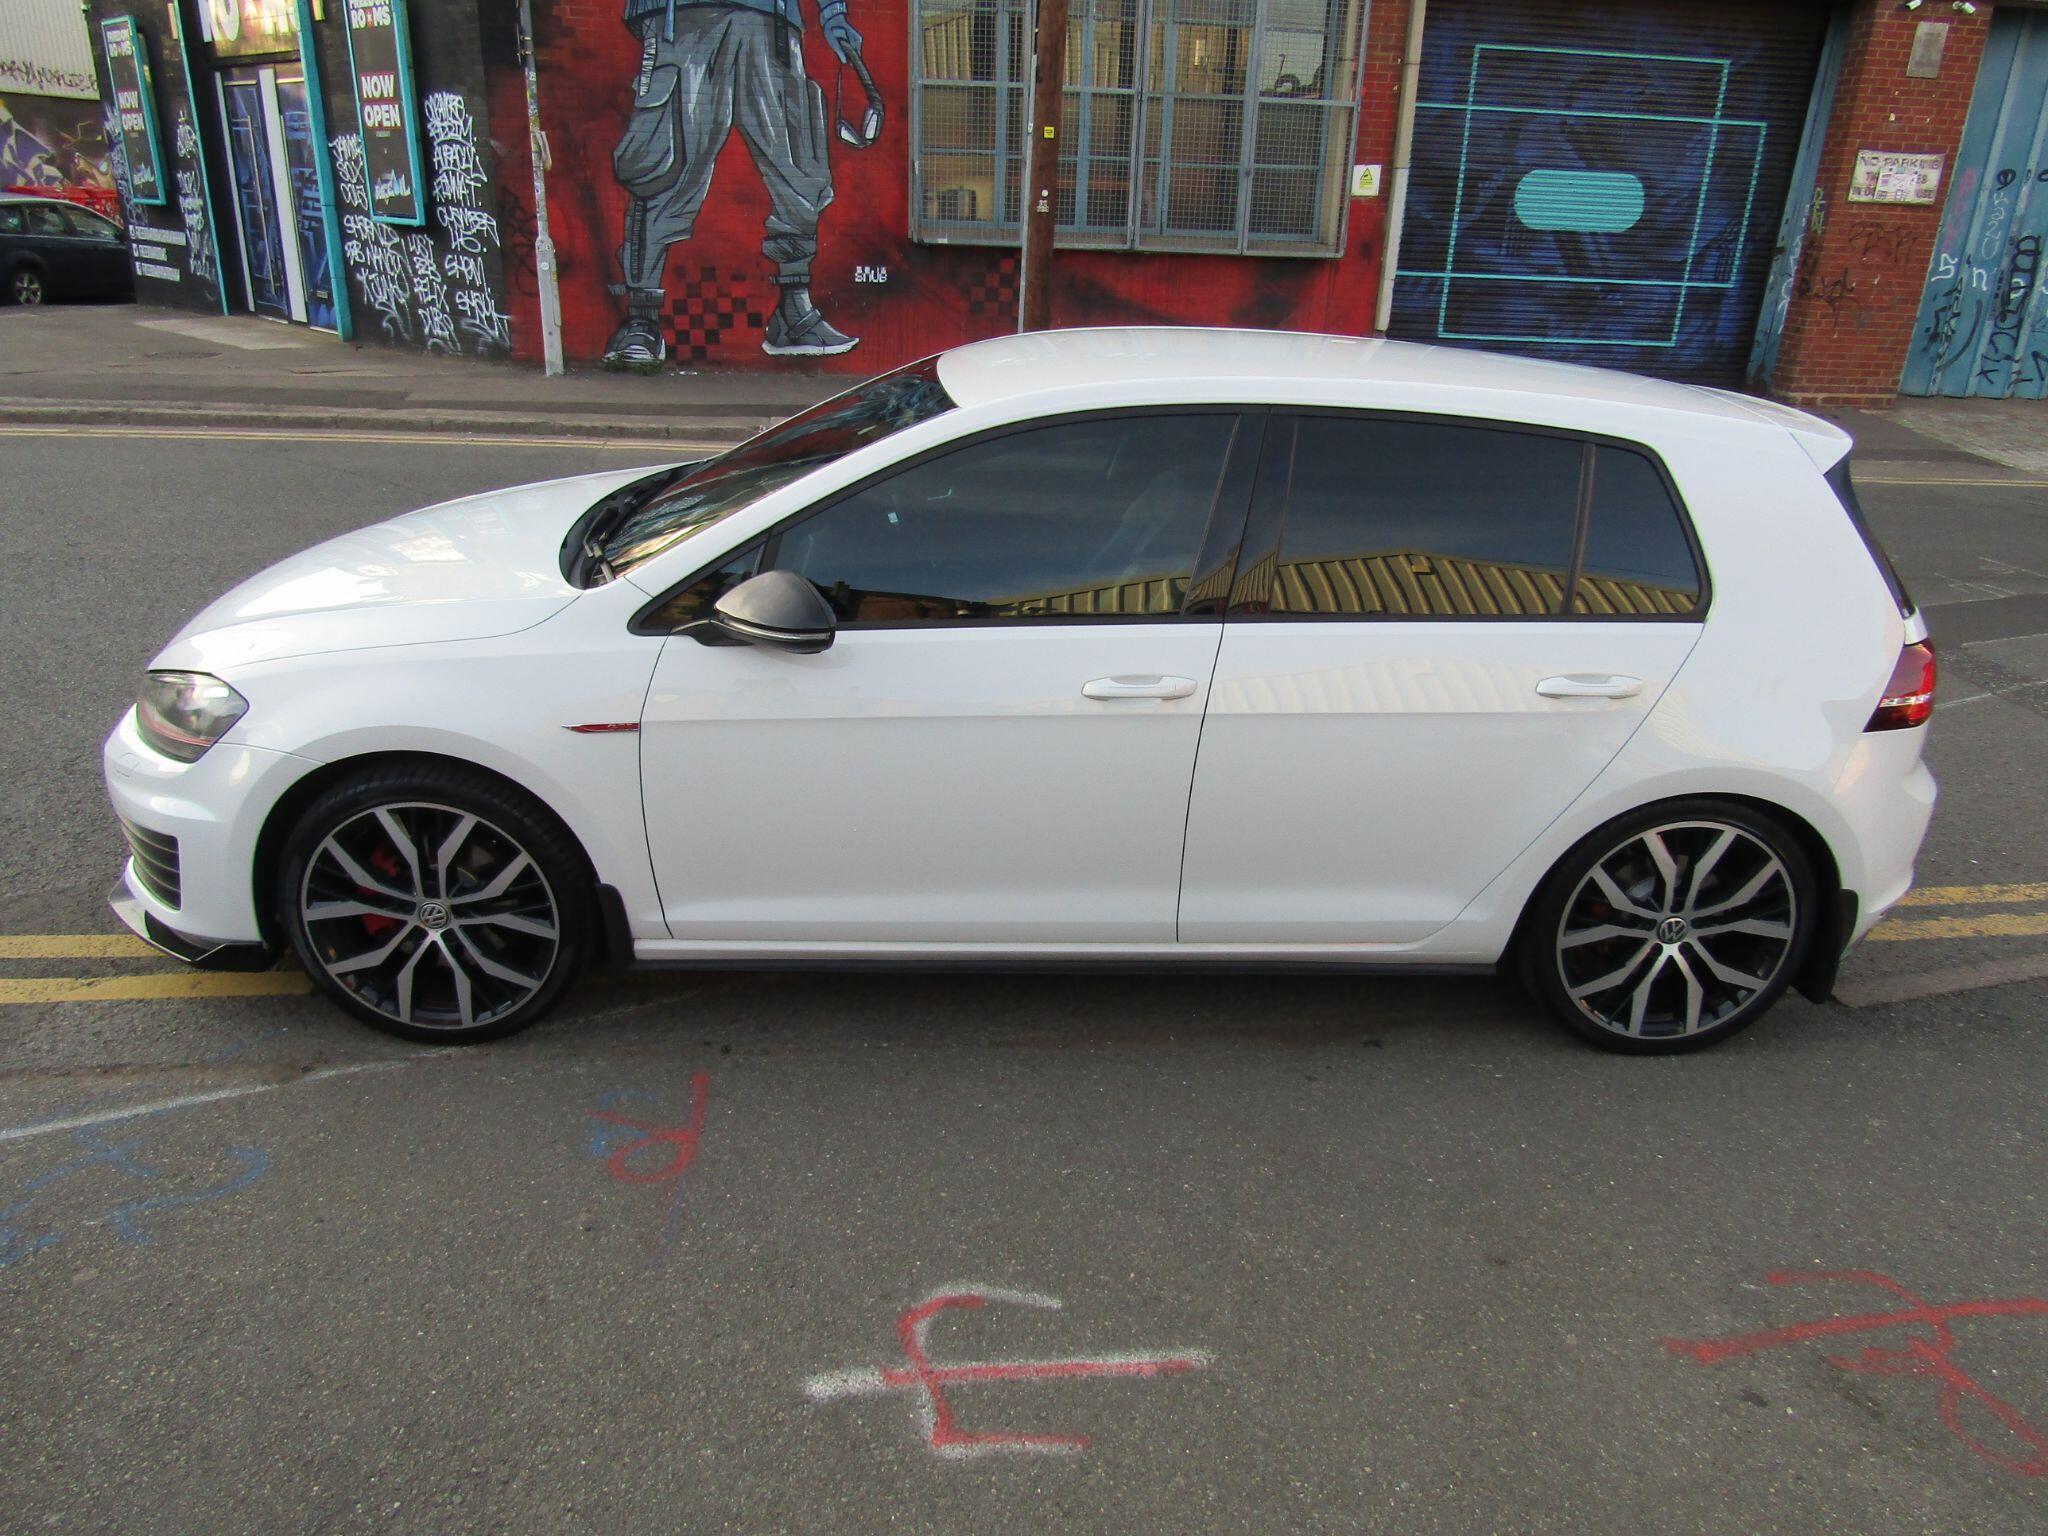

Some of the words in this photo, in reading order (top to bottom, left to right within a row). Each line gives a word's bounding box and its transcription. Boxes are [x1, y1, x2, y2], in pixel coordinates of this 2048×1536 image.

[361, 73, 395, 99] NOW
[118, 91, 138, 109] NOW
[121, 113, 145, 131] OPEN
[363, 103, 401, 128] OPEN
[1860, 155, 1879, 166] NO
